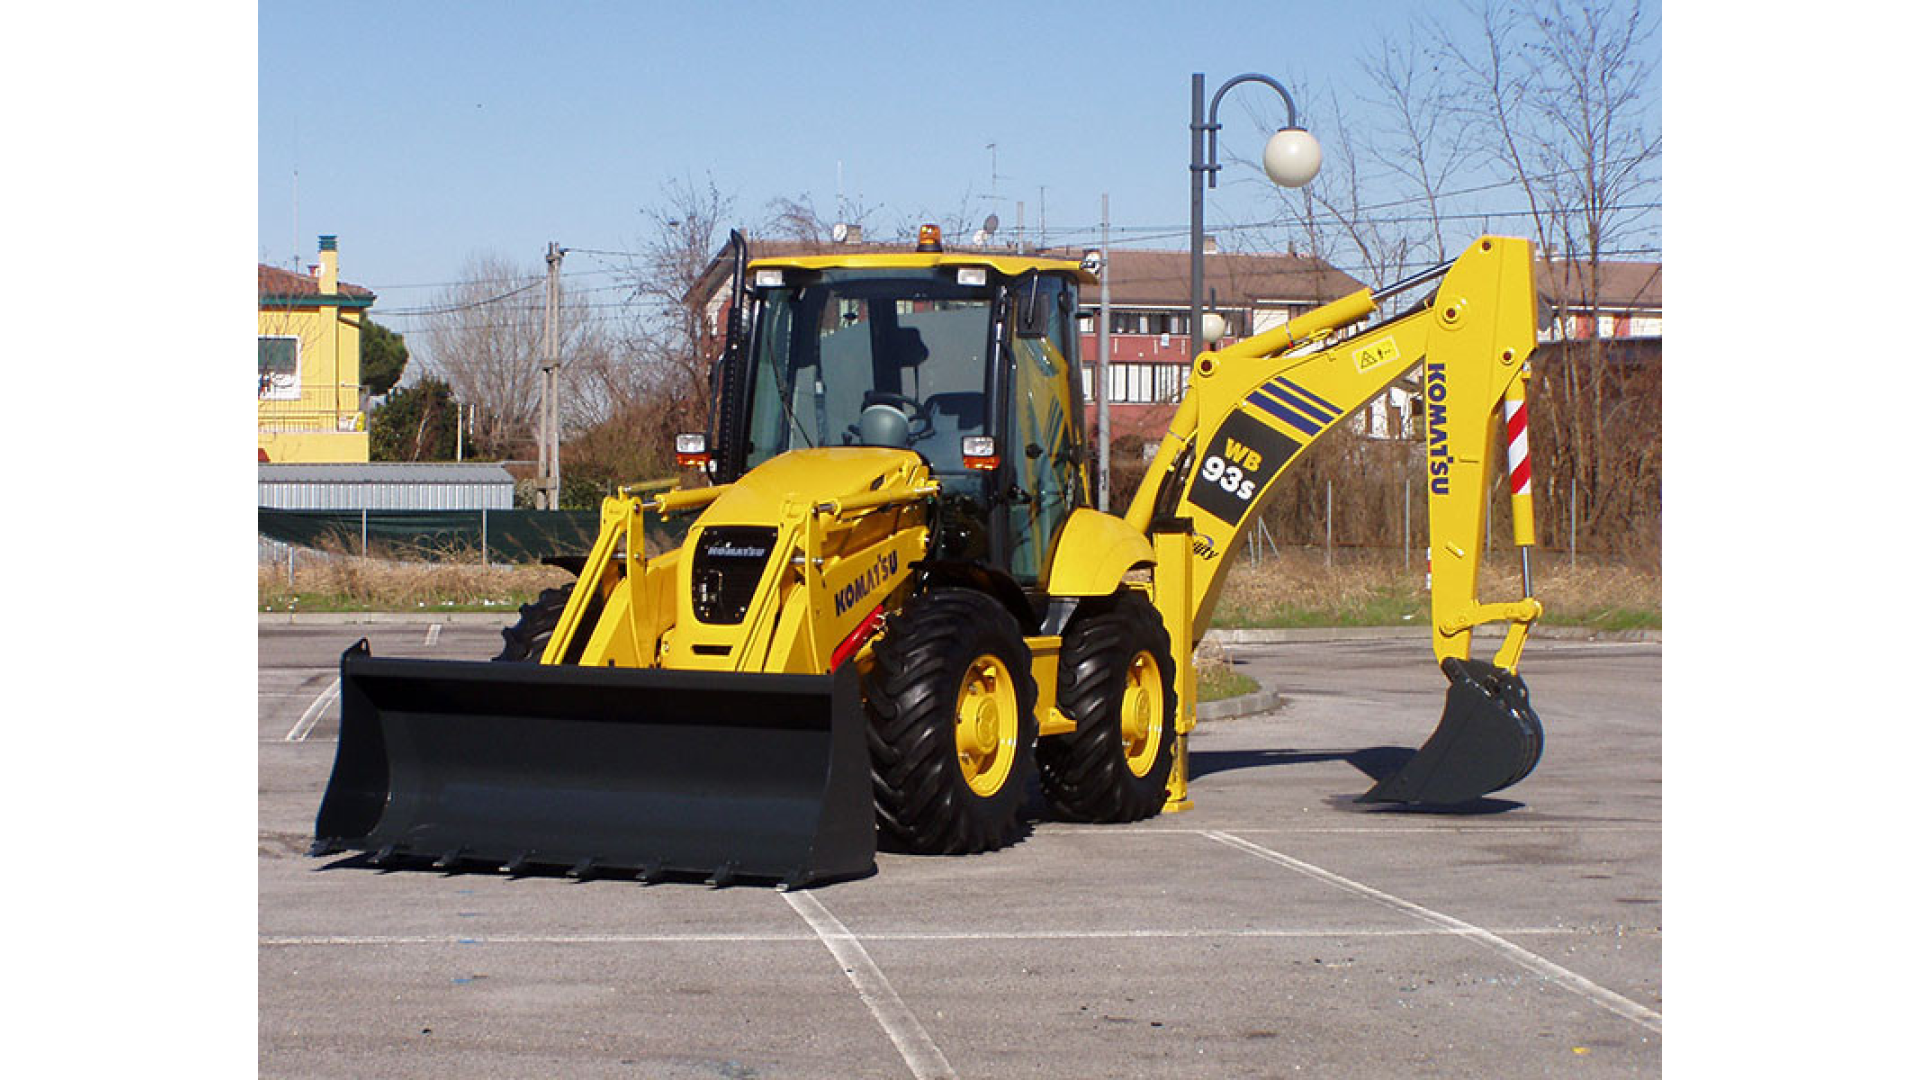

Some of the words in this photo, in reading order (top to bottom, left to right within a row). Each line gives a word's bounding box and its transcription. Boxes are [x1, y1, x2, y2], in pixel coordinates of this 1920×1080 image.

[1224, 437, 1262, 472] WB
[1427, 363, 1453, 495] KOMATSU
[707, 546, 765, 557] KOMATSU
[834, 550, 898, 617] KOMATSU
